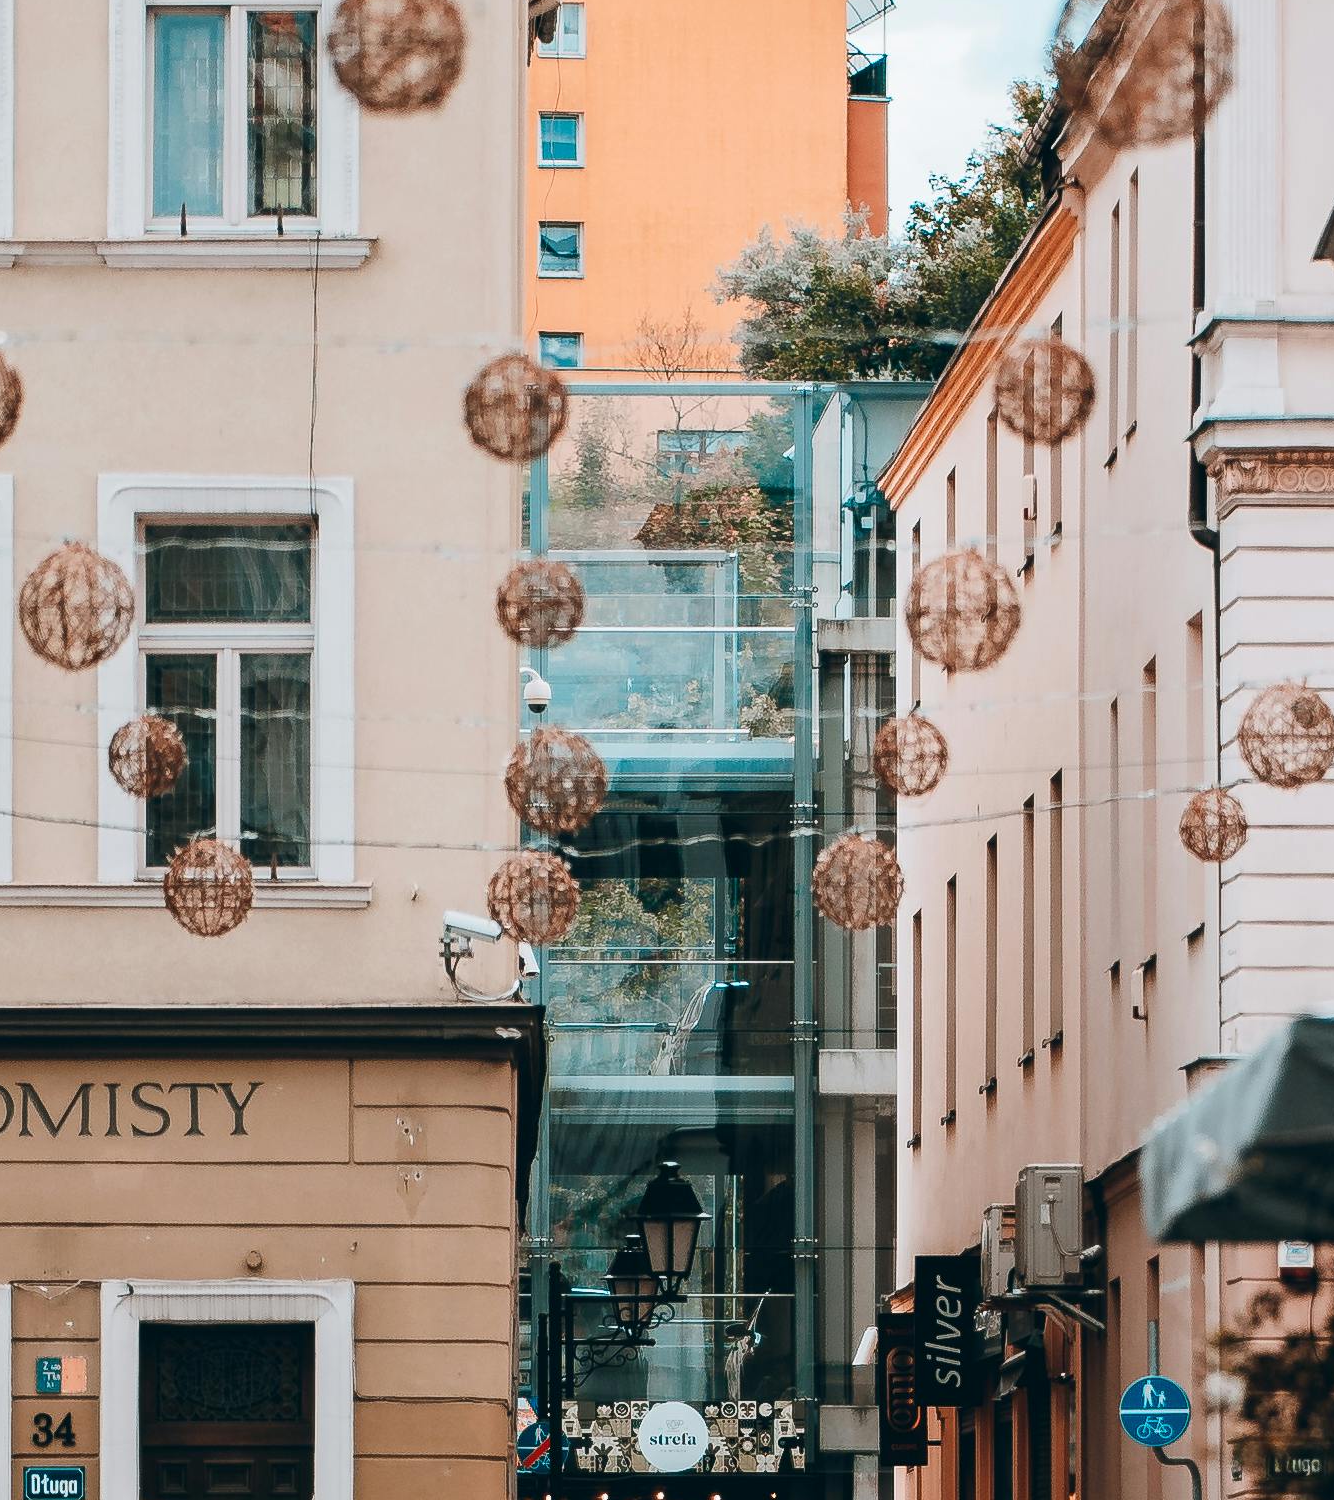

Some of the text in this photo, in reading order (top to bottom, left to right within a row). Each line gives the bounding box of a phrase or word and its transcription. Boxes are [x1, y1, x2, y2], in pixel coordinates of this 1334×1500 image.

[924, 1274, 962, 1388] silver
[31, 1411, 77, 1449] 34
[649, 1432, 697, 1446] strefa
[30, 1473, 78, 1498] Długa
